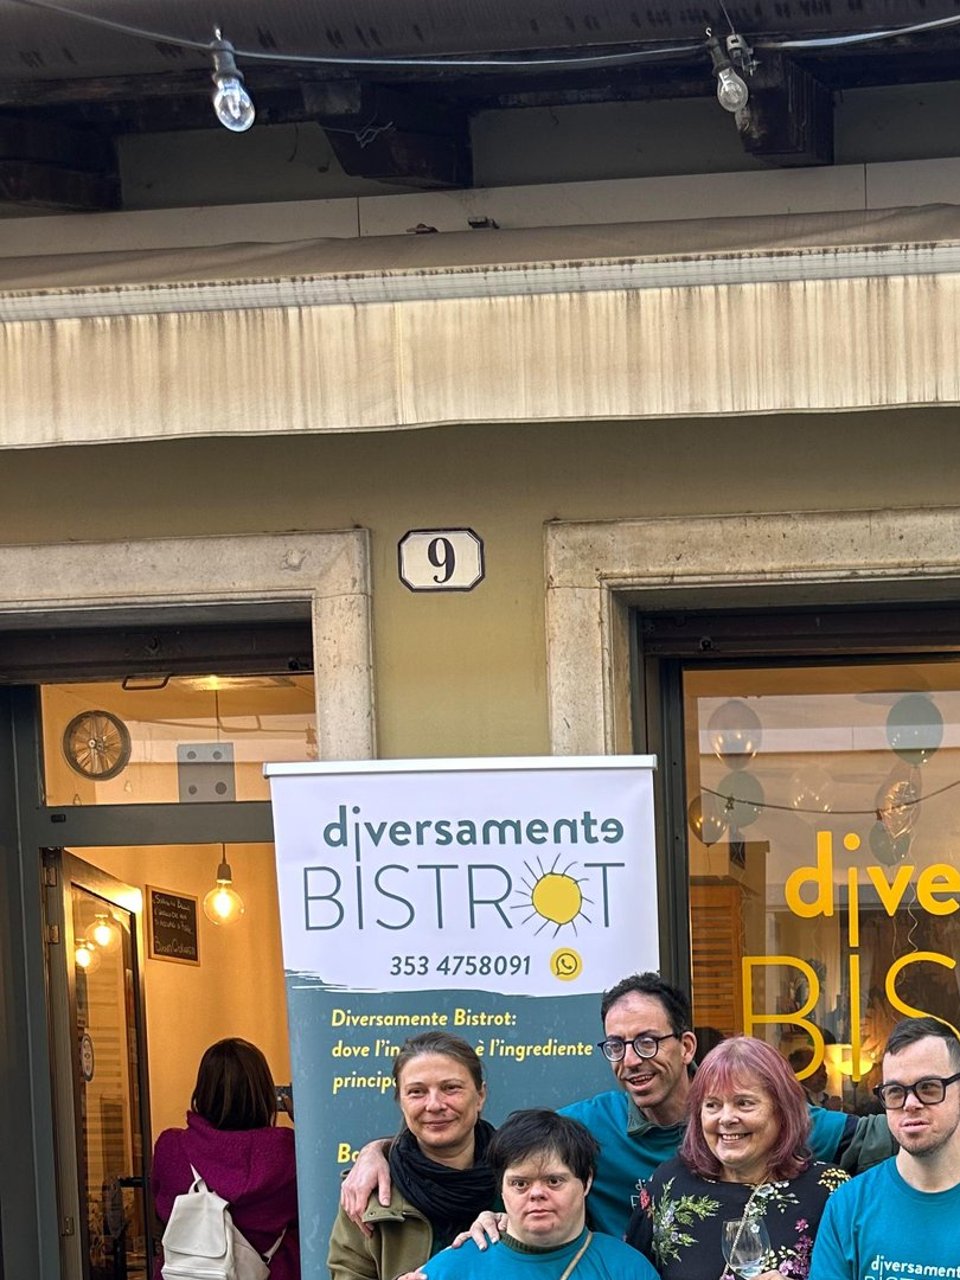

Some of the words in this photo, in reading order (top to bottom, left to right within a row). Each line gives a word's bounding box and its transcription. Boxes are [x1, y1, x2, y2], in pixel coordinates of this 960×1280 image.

[427, 537, 456, 584] 9
[322, 805, 625, 862] diversamente
[303, 860, 625, 932] BISTROT
[389, 955, 429, 976] 353
[436, 955, 531, 976] 4758091
[331, 1008, 448, 1027] Diversamente
[453, 1008, 517, 1027] Bistrot:
[331, 1040, 370, 1058] dove
[489, 1038, 593, 1063] l'ingrediente
